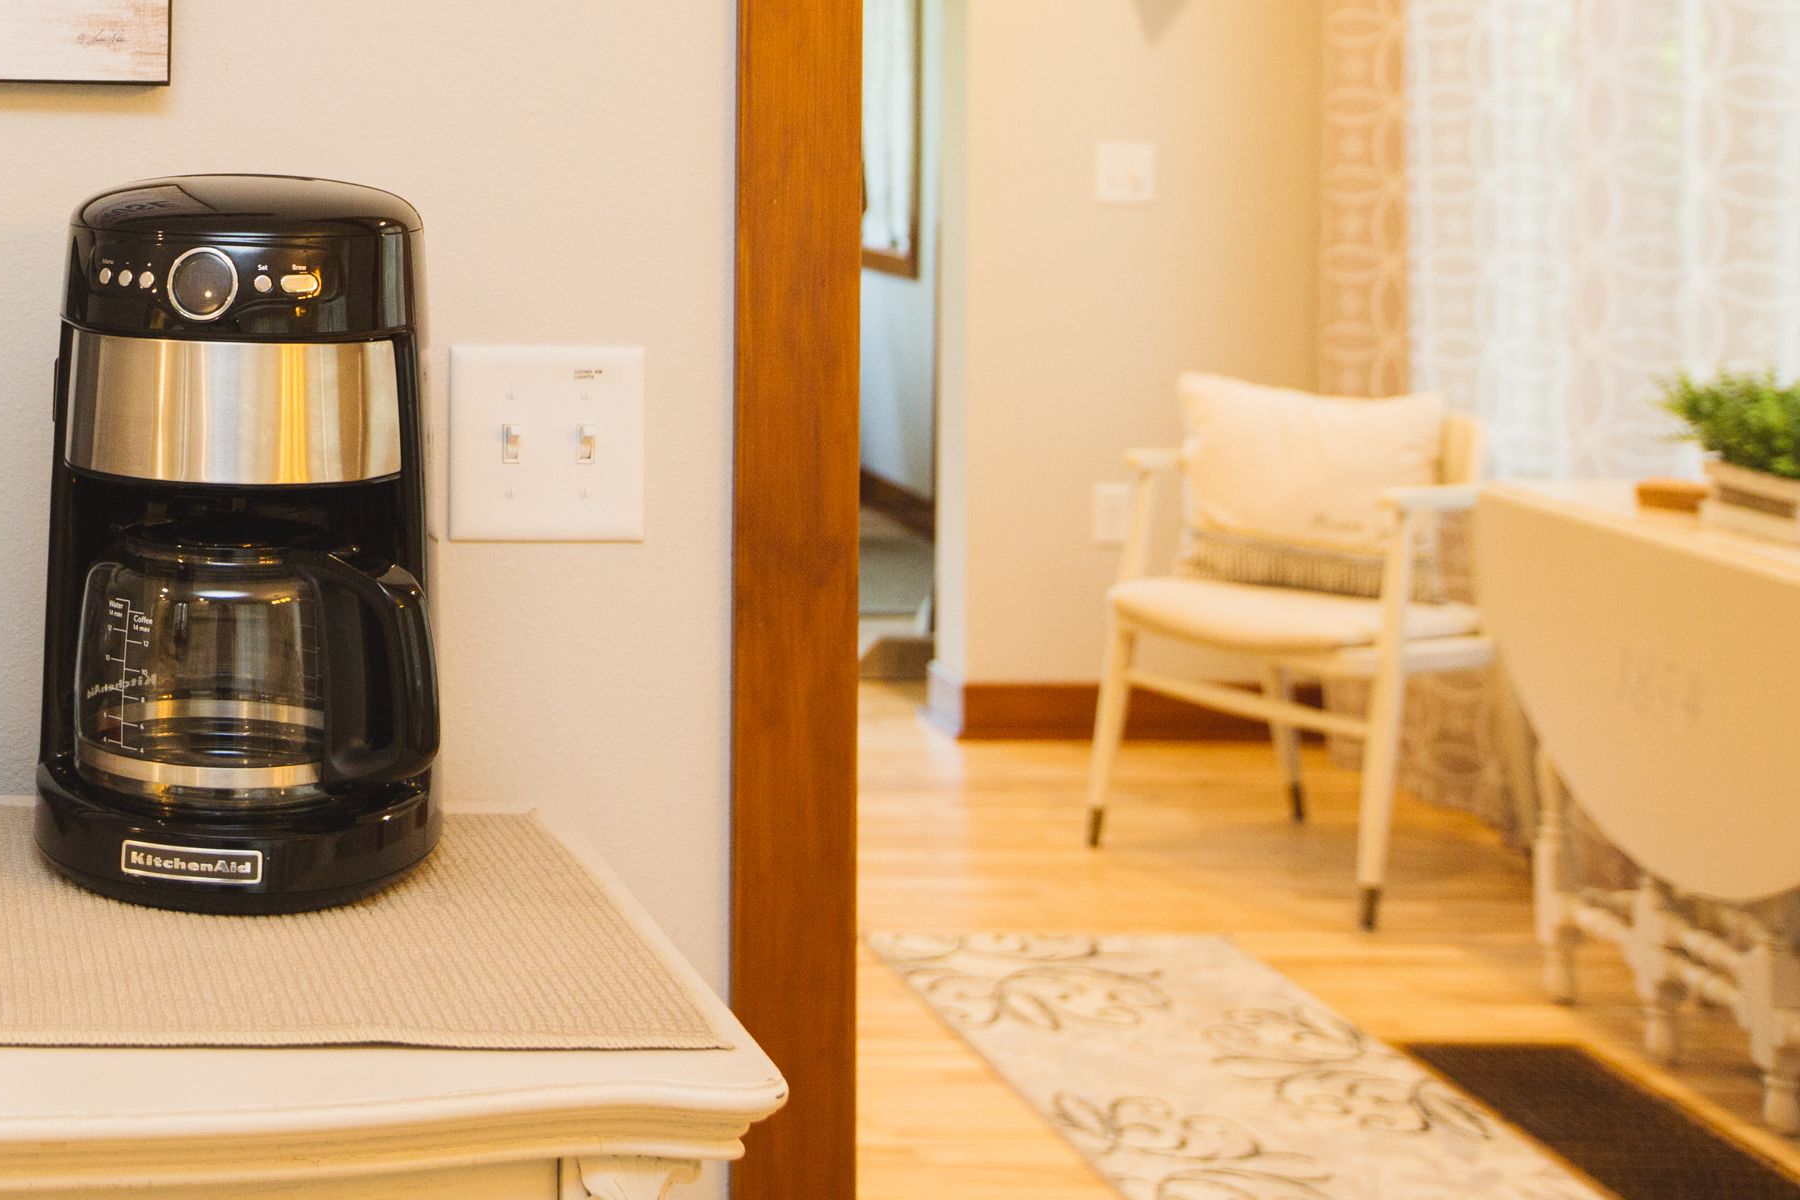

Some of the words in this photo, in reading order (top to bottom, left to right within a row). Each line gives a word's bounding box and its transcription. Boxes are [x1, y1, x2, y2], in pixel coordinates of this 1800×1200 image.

[109, 600, 124, 609] Water
[133, 615, 153, 626] Coffee
[130, 851, 252, 874] KitchenAid
